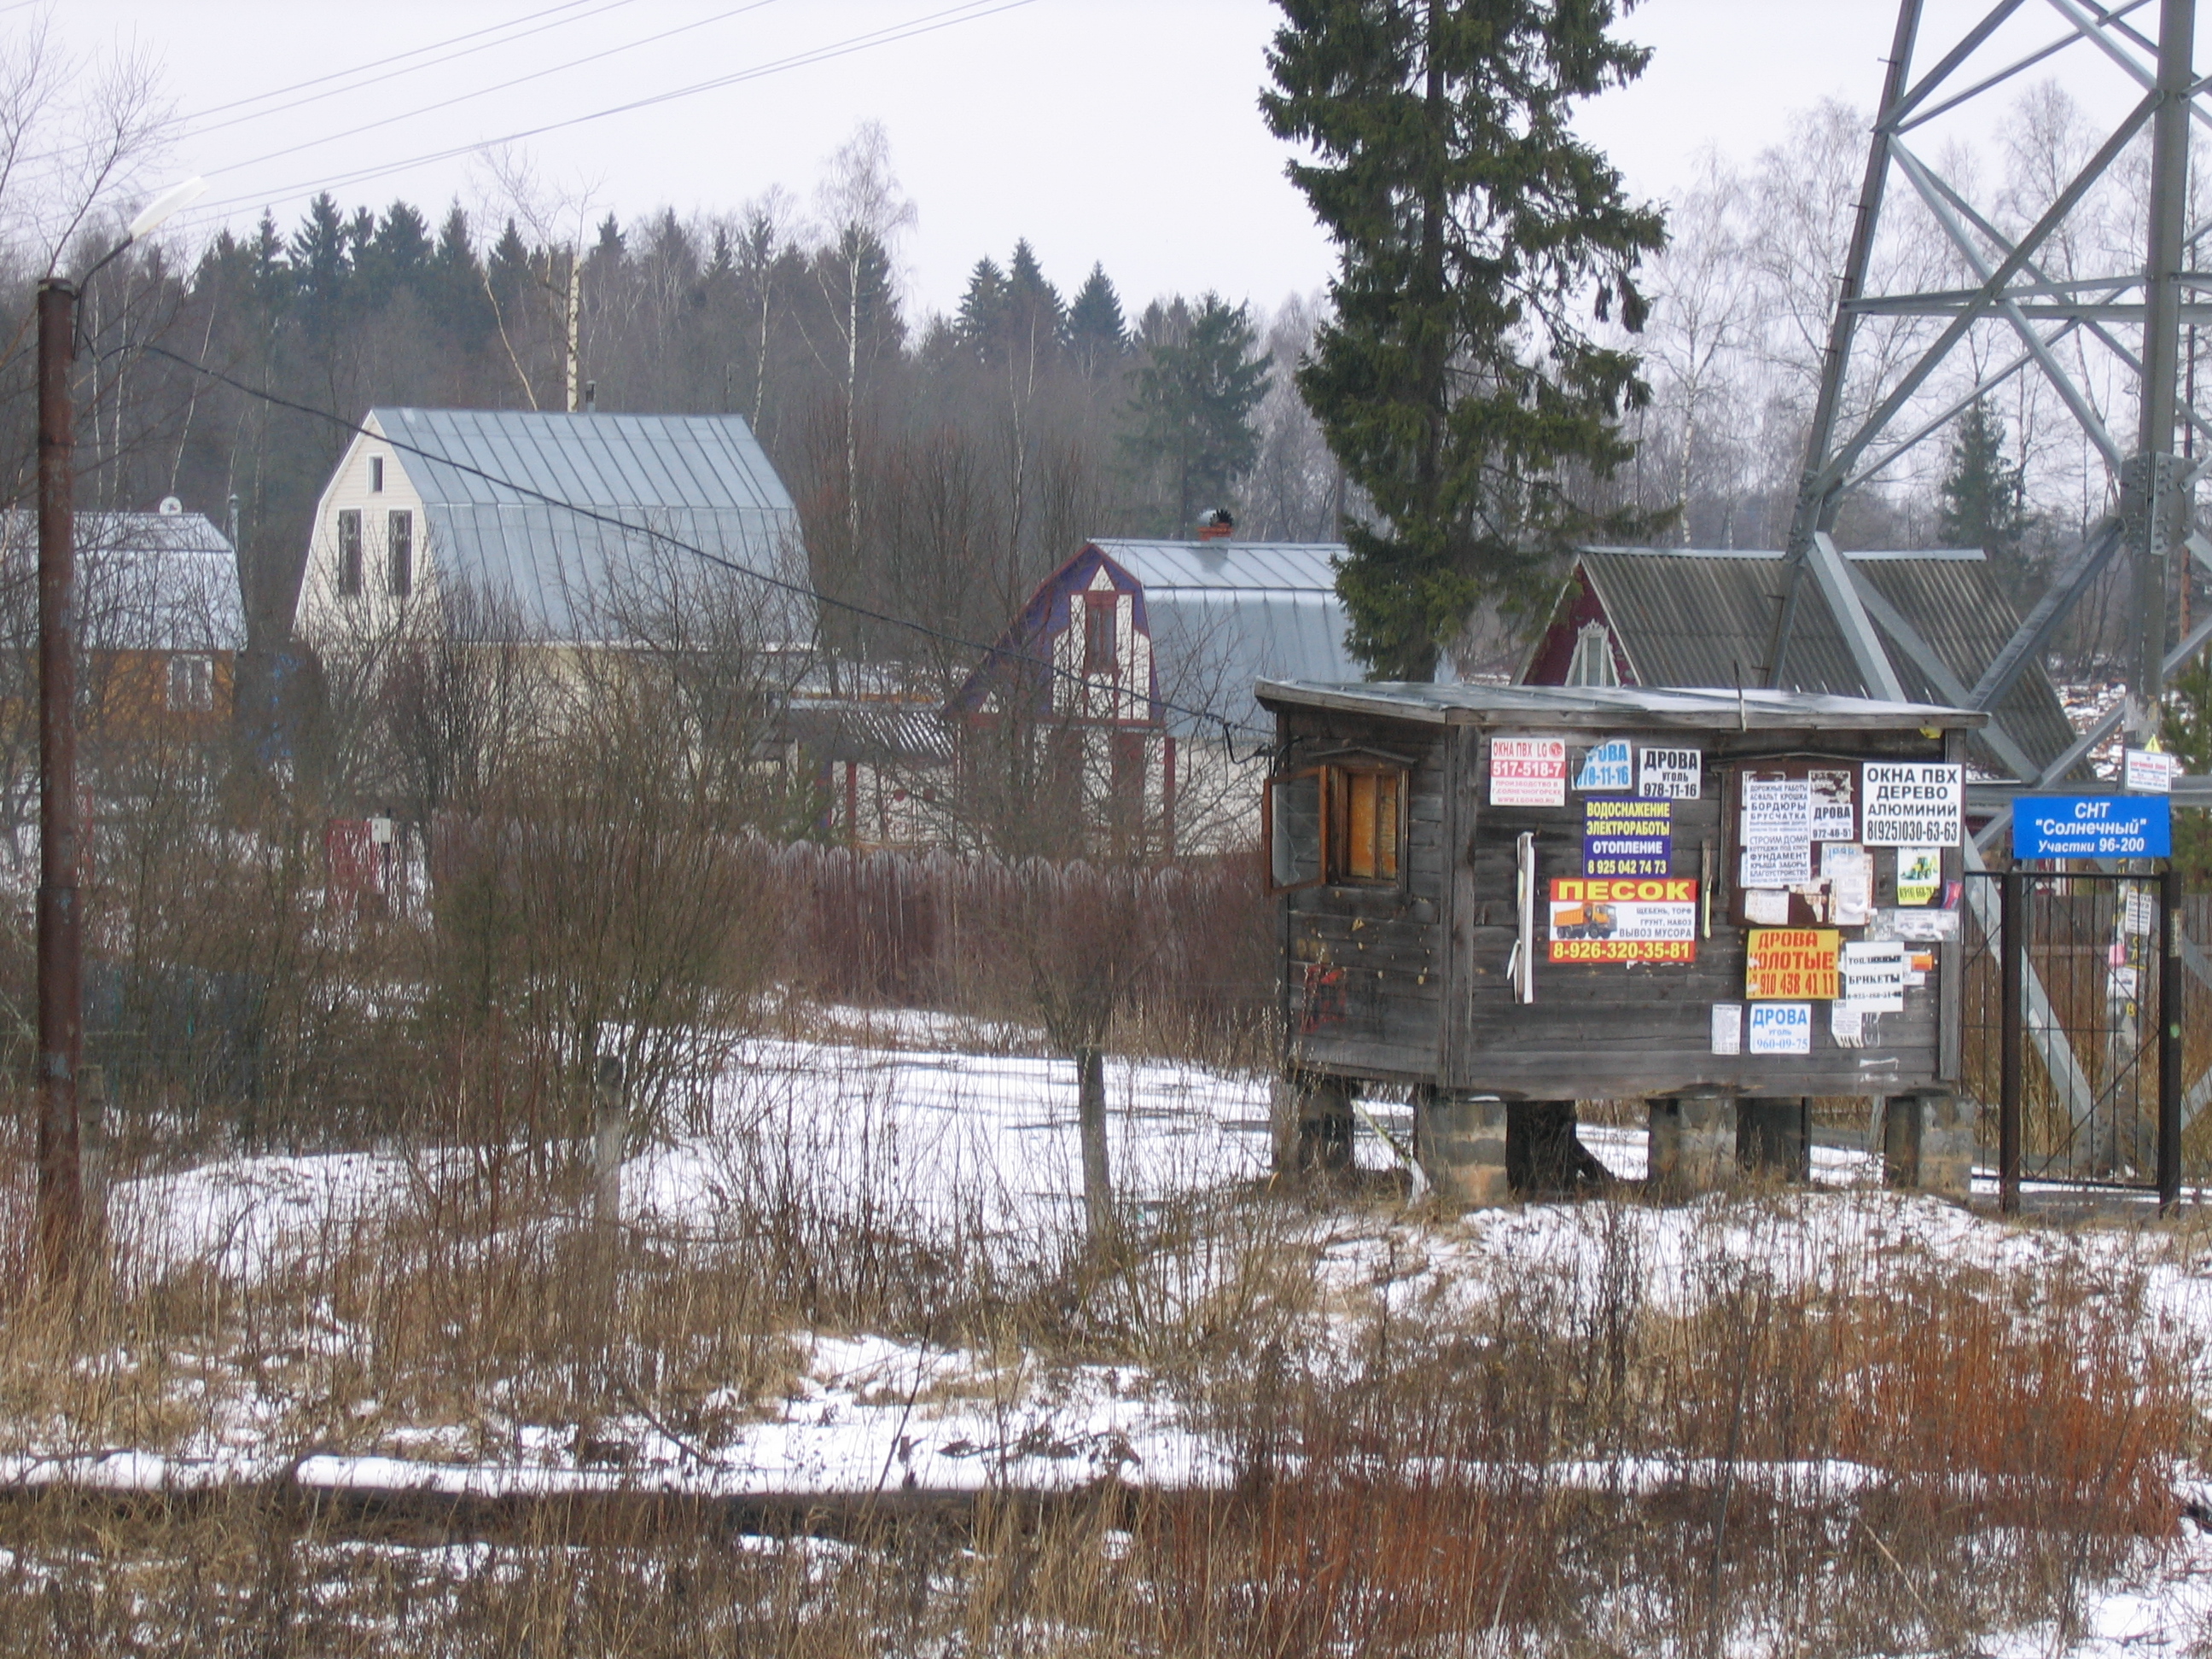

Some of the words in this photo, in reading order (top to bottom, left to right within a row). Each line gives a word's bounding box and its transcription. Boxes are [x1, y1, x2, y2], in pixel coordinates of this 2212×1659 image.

[1493, 742, 1514, 757] ОКНА
[1516, 742, 1533, 757] ПВХ
[1537, 742, 1547, 757] LG
[1644, 751, 1697, 771] ДРОВА
[1493, 761, 1563, 777] 517-518-7
[1867, 768, 1915, 783] ОКНА
[1922, 769, 1958, 783] ПВХ
[1644, 783, 1697, 797] 978-11-16
[1877, 785, 1948, 801] ДЕРЕВО
[1751, 802, 1807, 812] БОРДЮРЫ
[1814, 806, 1851, 821] ДРОВА
[1867, 802, 1957, 817] АЛЮМИНИЙ
[2075, 802, 2110, 819] СНТ
[1586, 820, 1670, 835] ЭЛЕКТРОРАБОТЫ
[1867, 820, 1958, 841] 8(925)030-63-63
[2035, 818, 2147, 835] "Солнечный"
[1749, 835, 1782, 844] СТРОИМ
[1784, 835, 1808, 844] ДОМА
[2038, 840, 2095, 853] Участки
[2098, 837, 2145, 852] 96-200
[1592, 841, 1663, 854] ОТОПЛЕНИЕ
[1587, 859, 1595, 874] 8
[1597, 859, 1615, 874] 925
[1618, 859, 1637, 874] 042
[1639, 859, 1652, 874] 74
[1654, 859, 1667, 874] 73
[1558, 881, 1690, 901] ПЕСОК
[1620, 928, 1652, 938] ВЫВОЗ
[1654, 928, 1691, 938] МУСОРА
[1759, 932, 1818, 950] ДРОВА
[1553, 941, 1690, 959] 8-926-320-35-81
[1761, 973, 1776, 995] 910
[1780, 973, 1801, 995] 438
[1805, 973, 1818, 995] 41
[1823, 973, 1835, 995] 11
[1848, 974, 1900, 985] БРИКЕТЫ
[1753, 1009, 1807, 1028] ДРОВА
